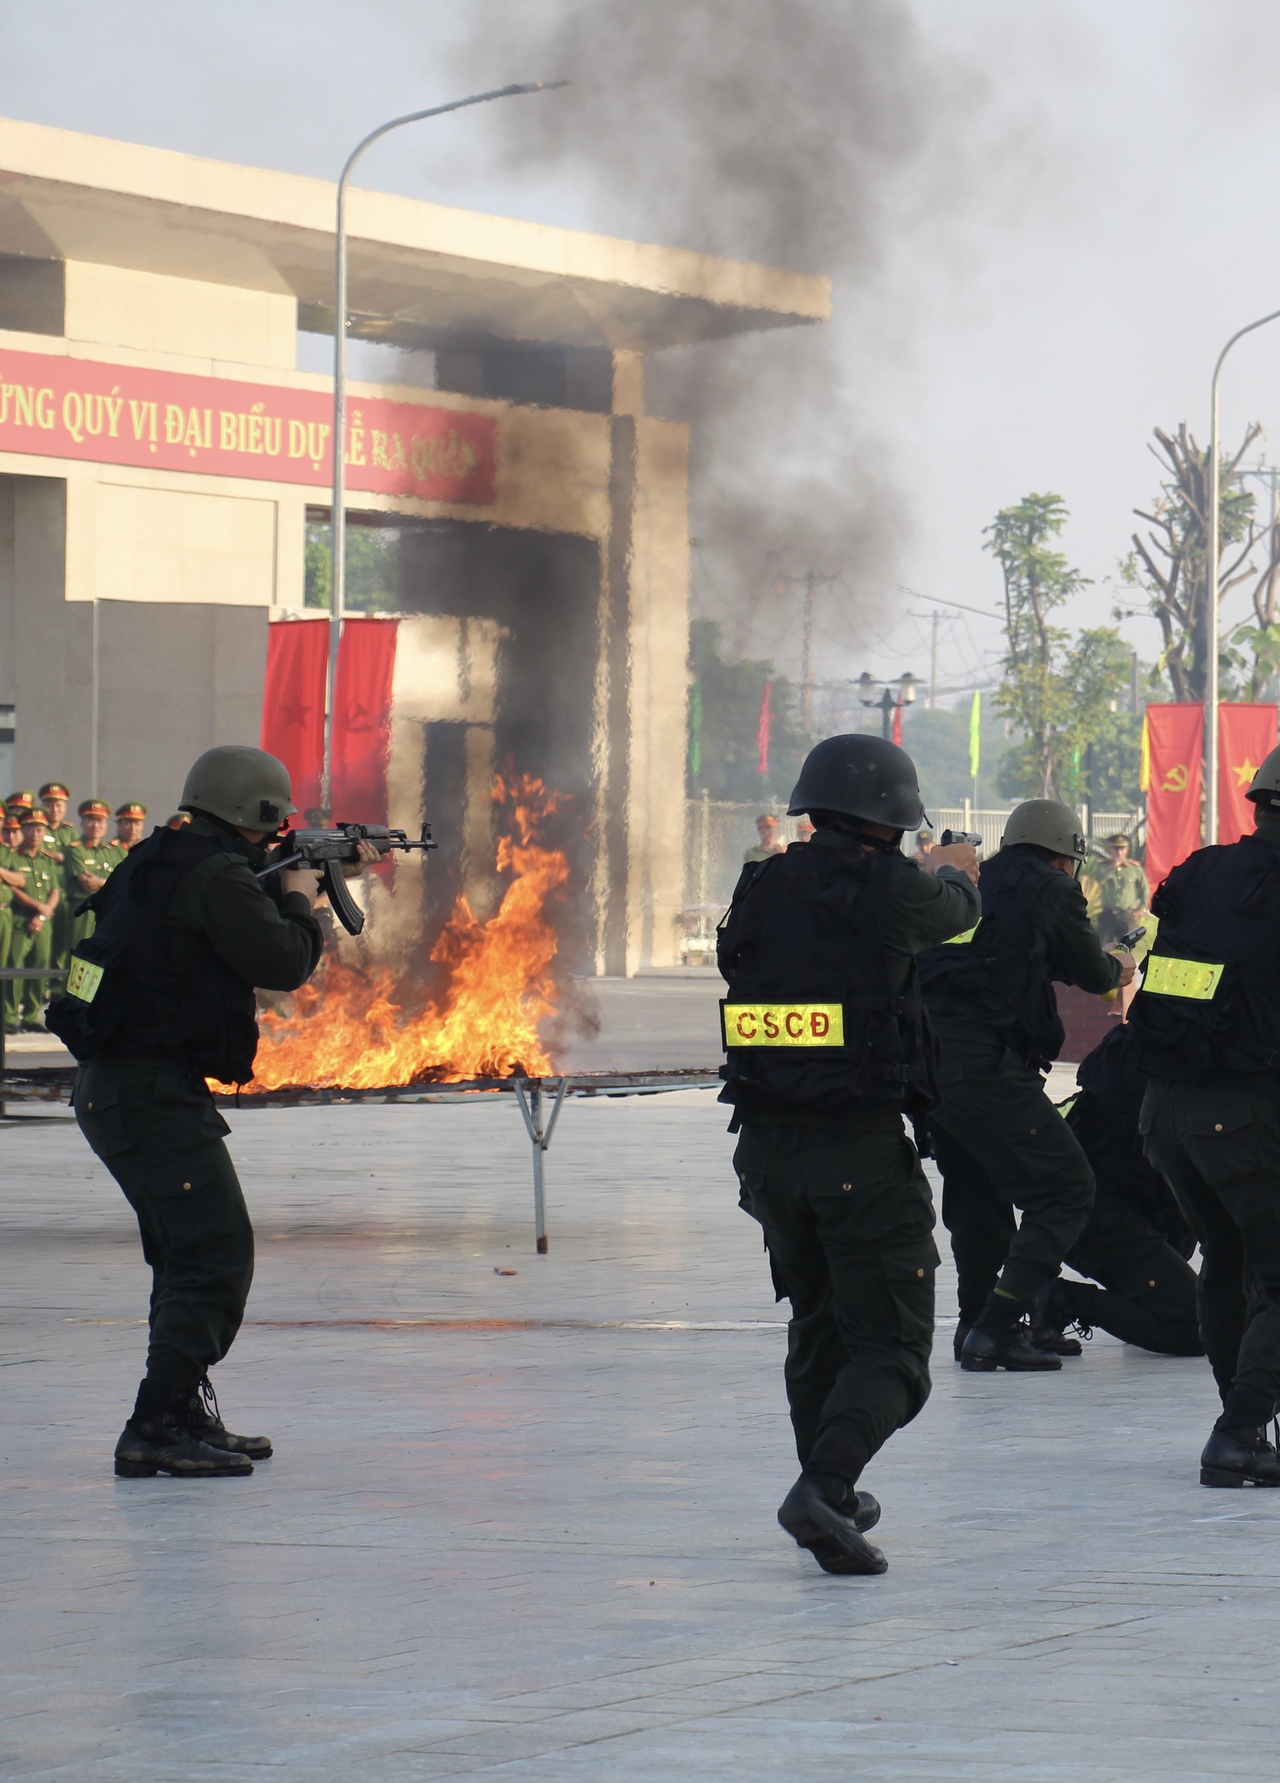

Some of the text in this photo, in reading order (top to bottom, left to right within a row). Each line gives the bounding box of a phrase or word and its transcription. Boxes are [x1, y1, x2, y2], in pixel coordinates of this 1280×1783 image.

[62, 385, 124, 443] QUÝ
[128, 400, 158, 452] VỊ
[164, 404, 213, 457] ĐẠI
[219, 402, 282, 457] BIỂU
[288, 419, 331, 471] DỰ
[344, 410, 366, 466] Ễ
[736, 1012, 830, 1039] CSCĐ
